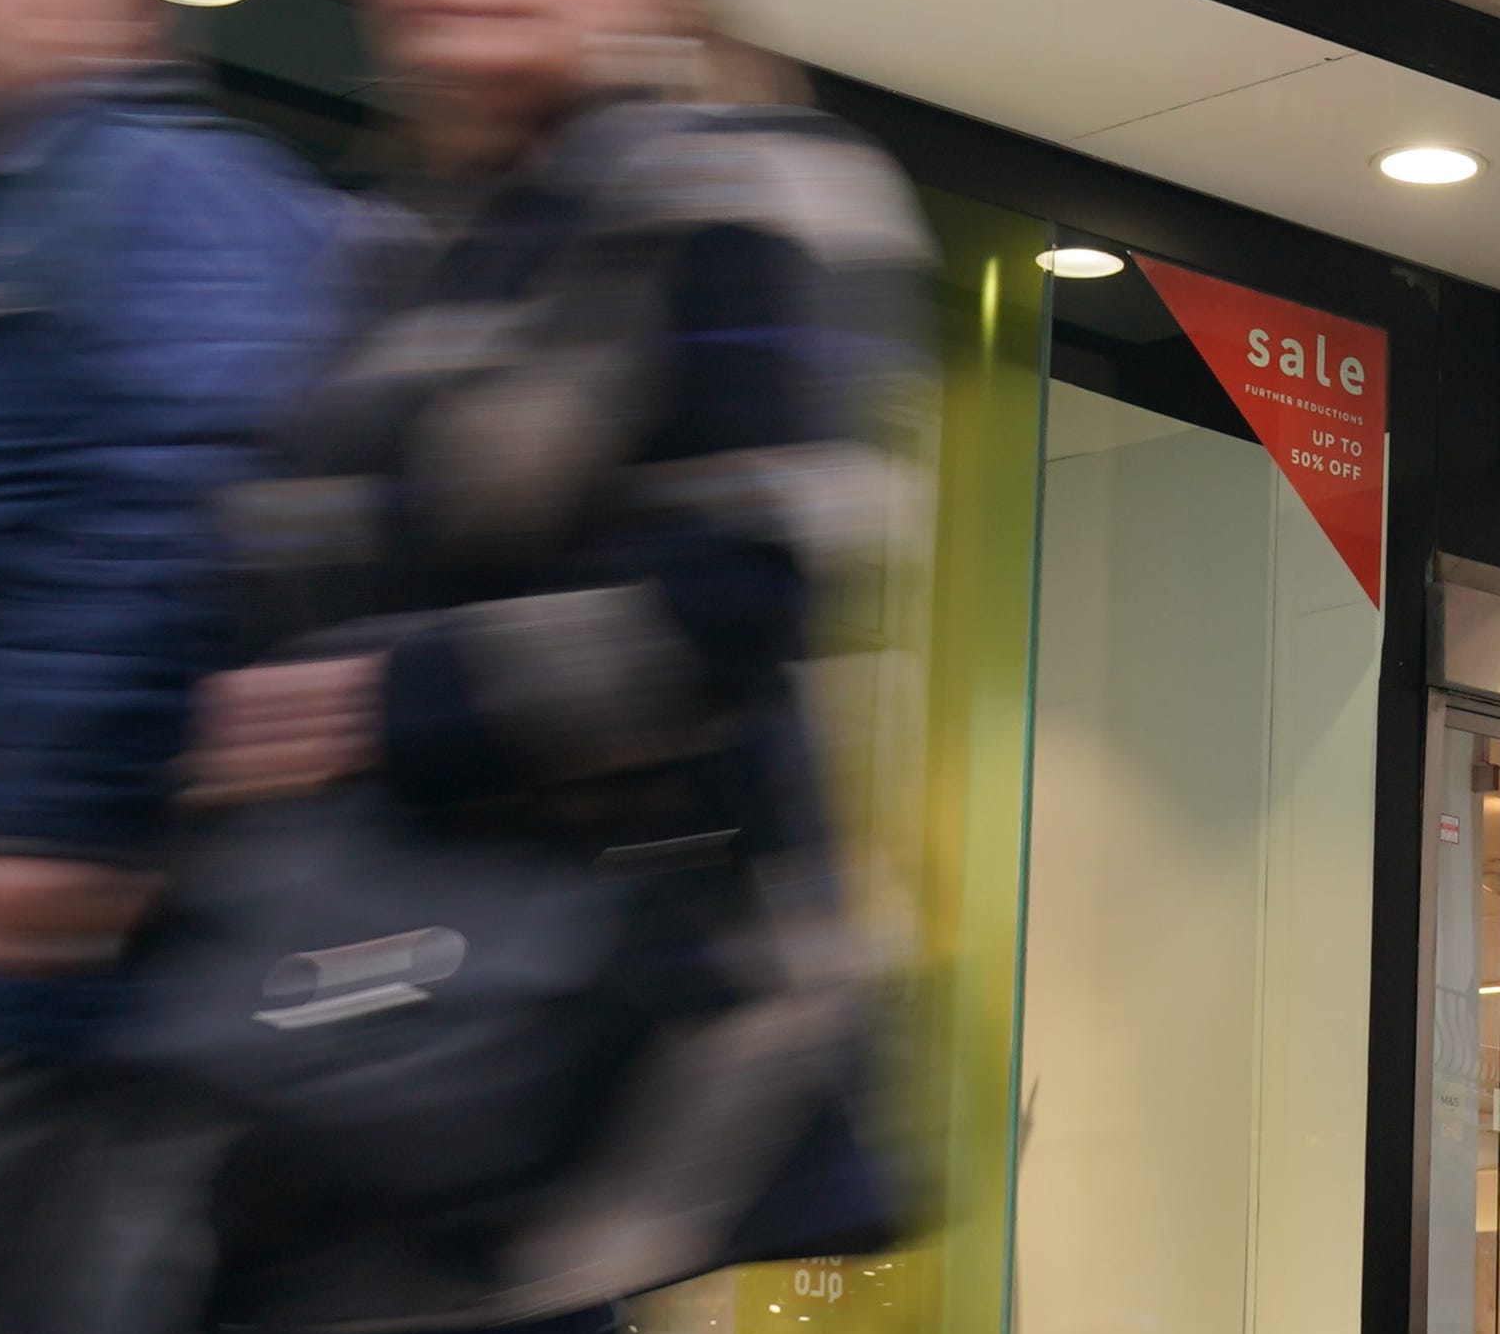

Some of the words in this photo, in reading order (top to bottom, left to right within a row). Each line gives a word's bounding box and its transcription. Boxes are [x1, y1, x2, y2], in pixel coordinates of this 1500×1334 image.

[1246, 328, 1366, 396] sale
[1245, 384, 1293, 406] FURTHER
[1297, 399, 1363, 426] REDUCTIONS
[1312, 430, 1335, 448] UP
[1341, 438, 1362, 457] TO
[1291, 448, 1324, 472] 50%
[1329, 459, 1362, 481] OFF
